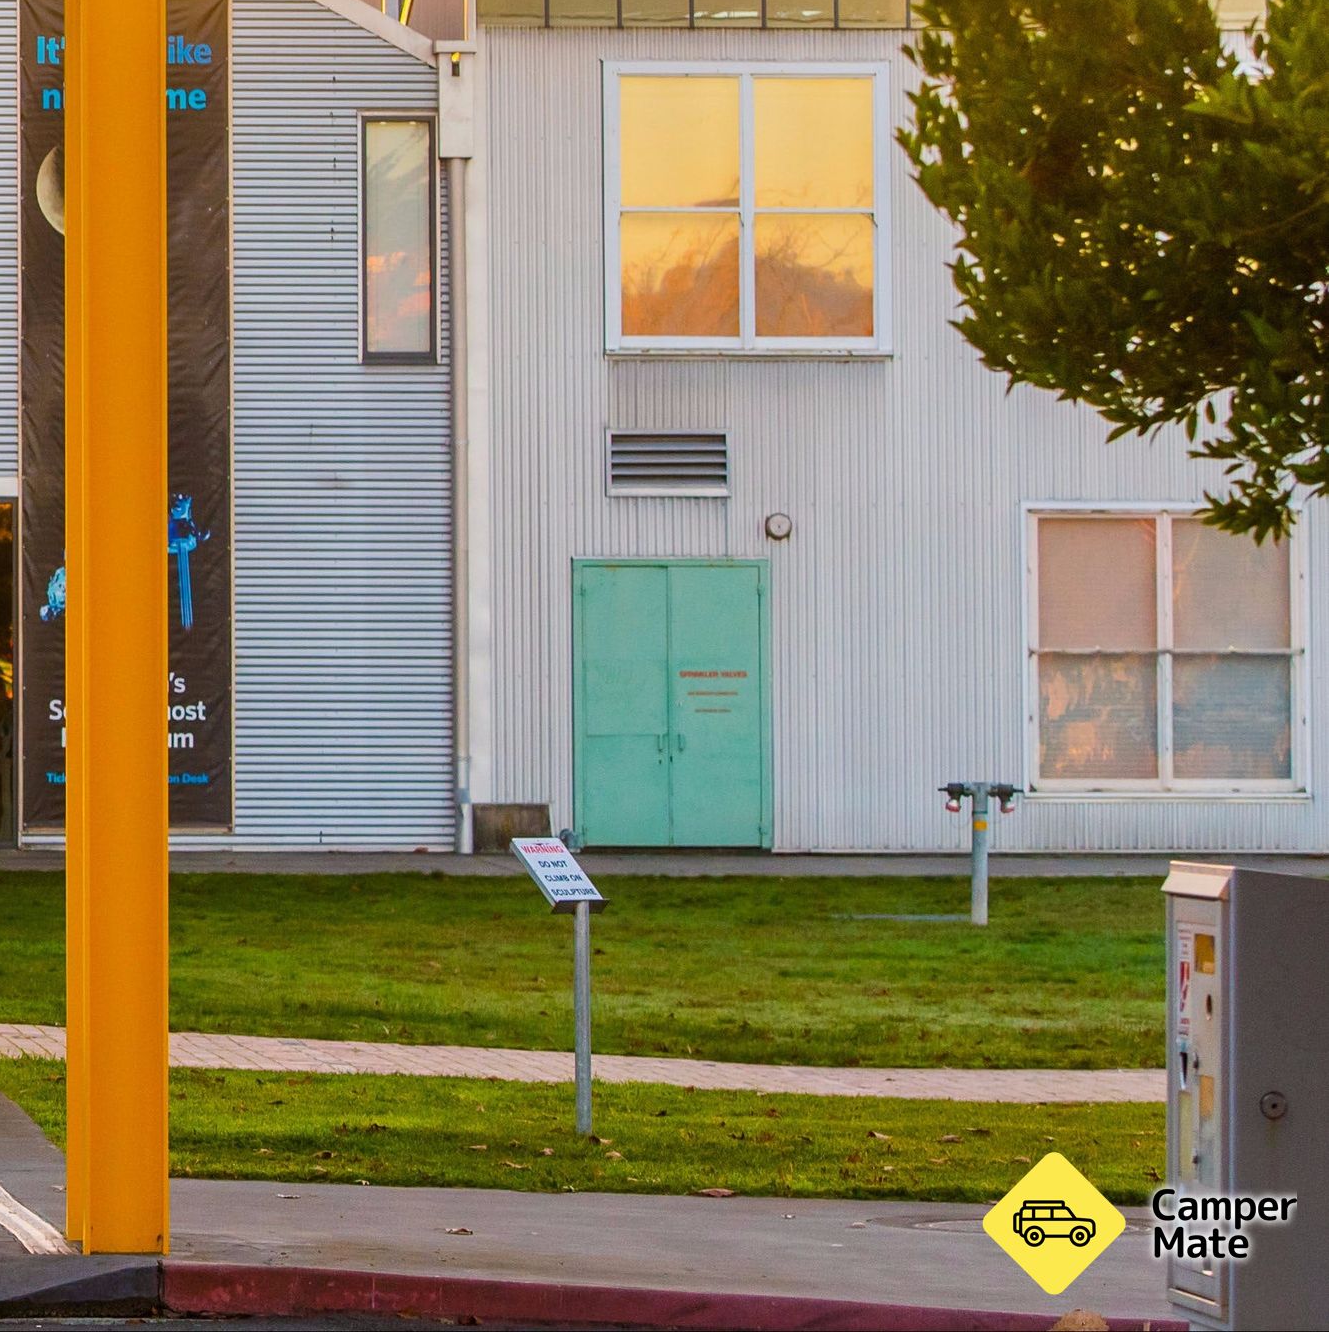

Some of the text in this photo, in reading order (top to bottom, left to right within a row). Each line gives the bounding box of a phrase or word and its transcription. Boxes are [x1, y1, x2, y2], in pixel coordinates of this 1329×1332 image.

[37, 35, 212, 65] It' ike
[166, 88, 207, 110] me
[182, 773, 209, 783] Desk
[521, 845, 564, 854] WARNING
[538, 860, 568, 868] DO NOT
[544, 874, 583, 882] CLIMB ON
[551, 888, 597, 896] SCULPTURE
